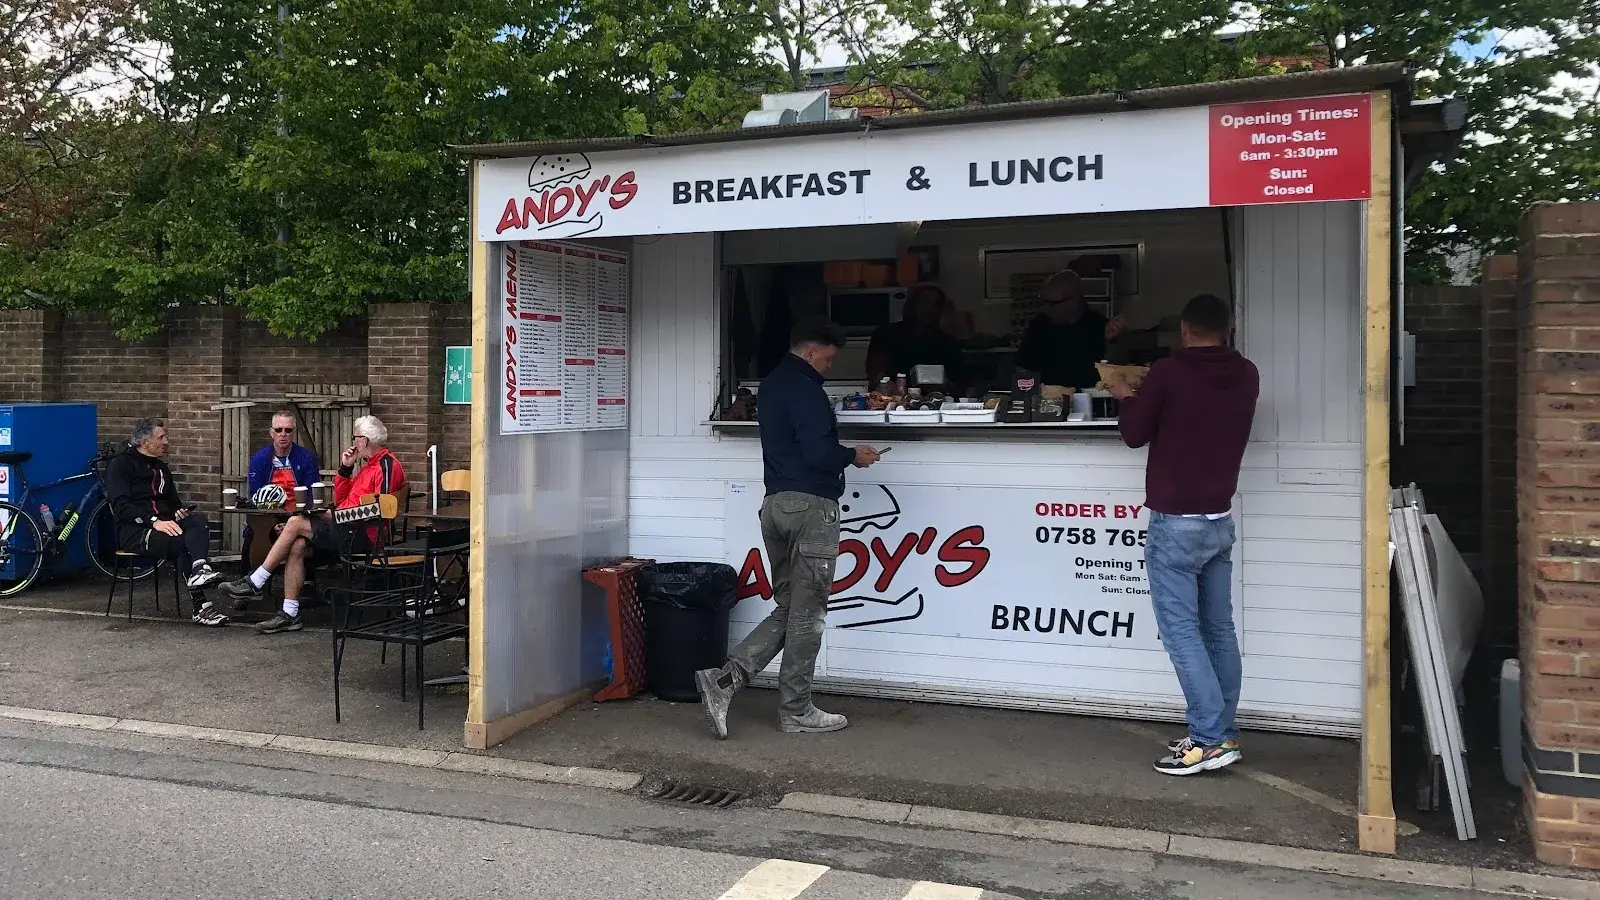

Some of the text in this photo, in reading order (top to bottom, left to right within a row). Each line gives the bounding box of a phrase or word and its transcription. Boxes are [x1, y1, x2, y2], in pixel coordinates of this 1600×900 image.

[1220, 108, 1359, 129] Opening Times:
[1251, 129, 1327, 145] Mon-Sat:
[1240, 150, 1271, 161] 6am
[1284, 146, 1338, 159] 3:30pm
[672, 154, 1104, 205] BREAKFAST & LUNCH
[1270, 167, 1308, 180] Sun:
[1263, 183, 1314, 196] Closed
[496, 171, 638, 235] ANDY'S
[505, 244, 518, 421] ANDY'S MENU
[1035, 502, 1142, 519] ORDER BY
[1035, 526, 1097, 546] 0758
[736, 525, 991, 601] ADY'S
[1074, 556, 1133, 571] Opening
[1075, 572, 1095, 580] Mon
[1098, 573, 1117, 581] Sat:
[1120, 574, 1141, 582] 6am
[1101, 585, 1123, 594] Sun:
[991, 604, 1135, 639] BRUNCH
